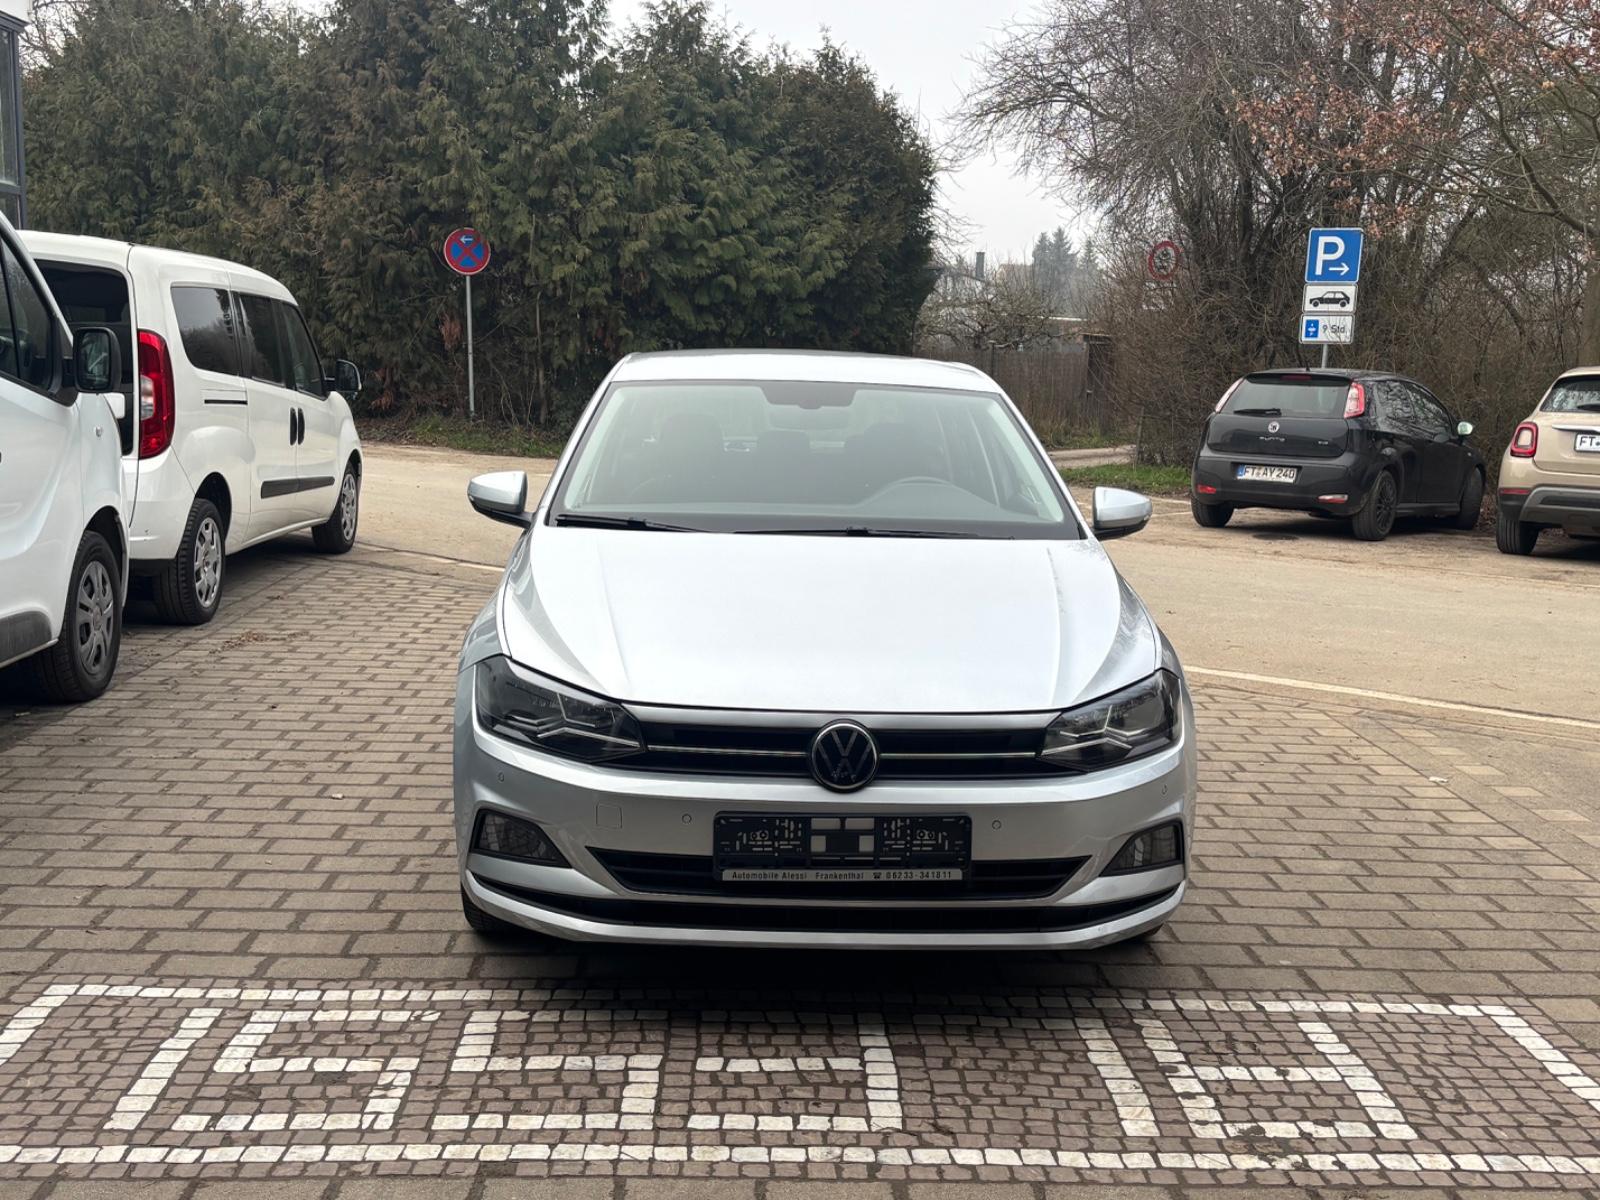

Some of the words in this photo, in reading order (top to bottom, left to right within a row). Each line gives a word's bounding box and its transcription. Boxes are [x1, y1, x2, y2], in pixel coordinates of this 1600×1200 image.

[1315, 236, 1345, 275] P
[1262, 467, 1276, 478] AY
[1276, 468, 1295, 479] 240
[732, 871, 779, 880] Automobile
[782, 871, 807, 880] Alessi
[815, 871, 864, 880] Frankenthal
